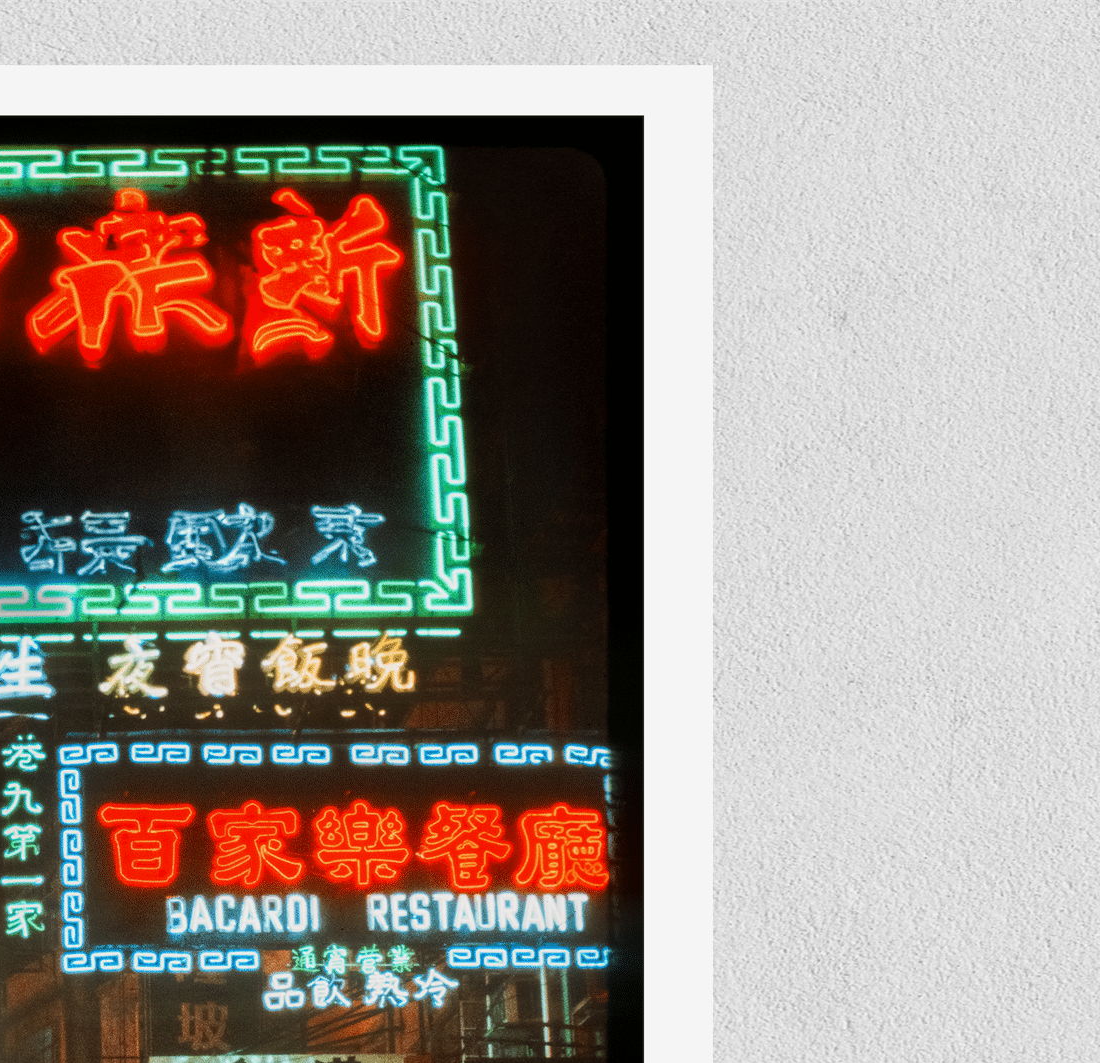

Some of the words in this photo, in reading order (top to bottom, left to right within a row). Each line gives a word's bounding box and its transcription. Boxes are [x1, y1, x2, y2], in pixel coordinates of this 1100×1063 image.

[0, 733, 46, 938] 港九第一家
[98, 799, 610, 891] 百家樂餐廳
[165, 893, 321, 933] BACARDI
[367, 891, 589, 932] RESTAURANT
